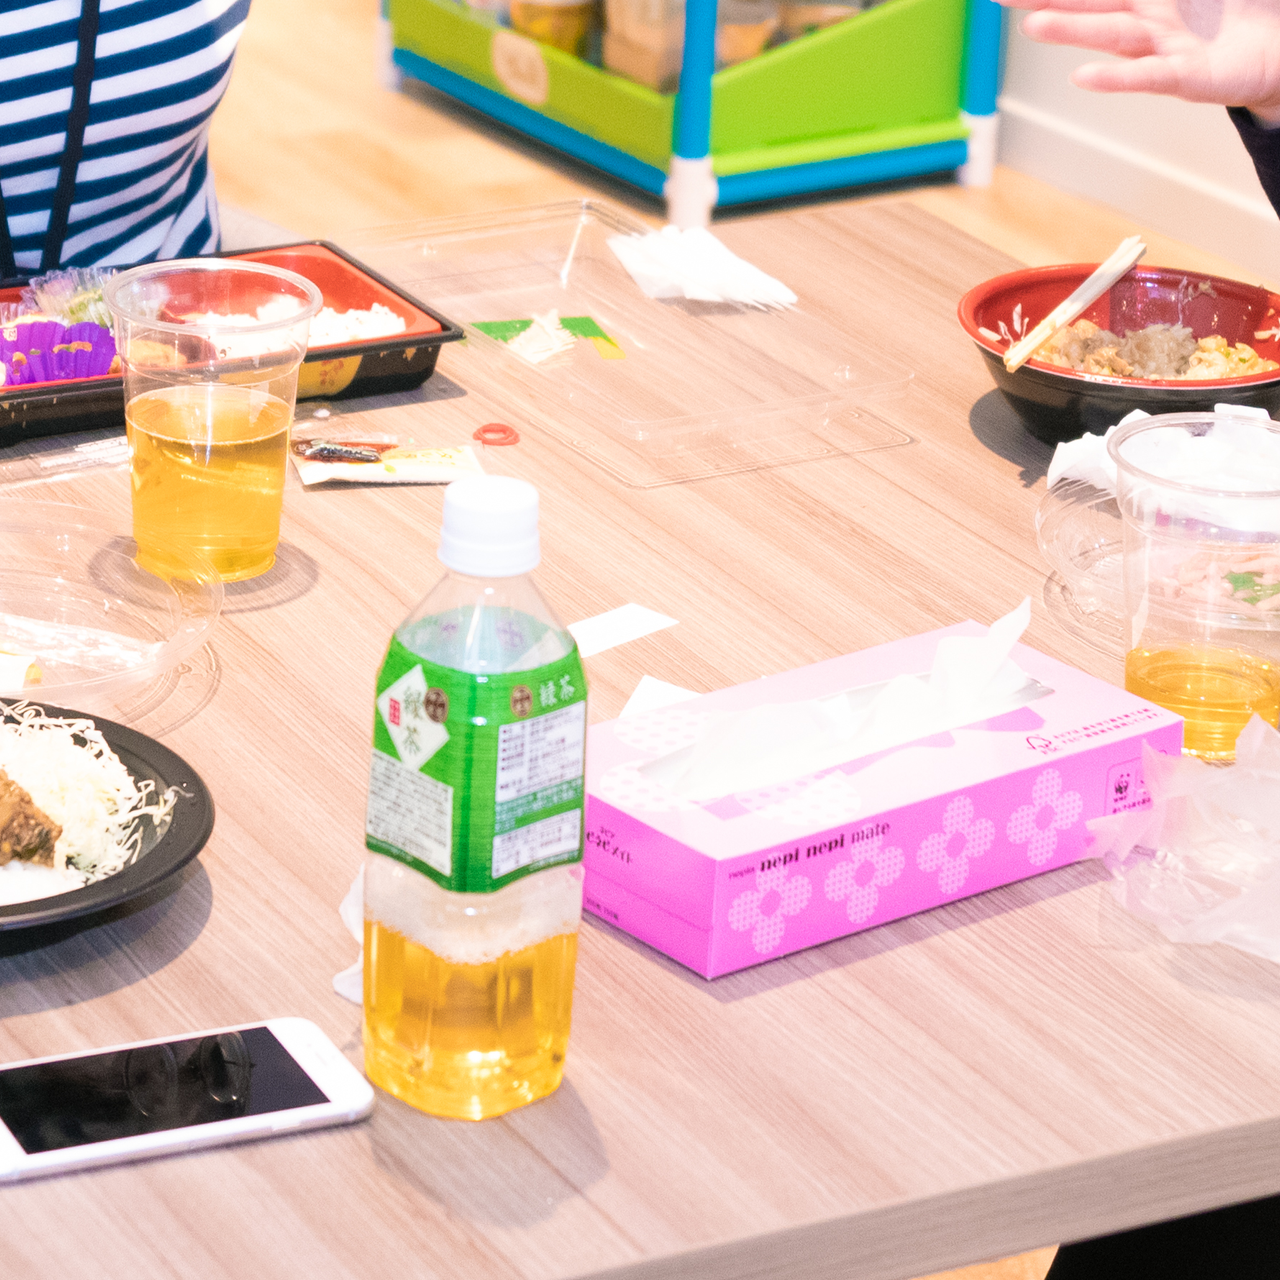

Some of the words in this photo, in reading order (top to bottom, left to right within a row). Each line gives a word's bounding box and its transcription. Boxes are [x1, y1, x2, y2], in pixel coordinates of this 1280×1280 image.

[760, 847, 799, 872] nepi
[806, 833, 844, 858] nepi
[851, 822, 891, 844] mate
